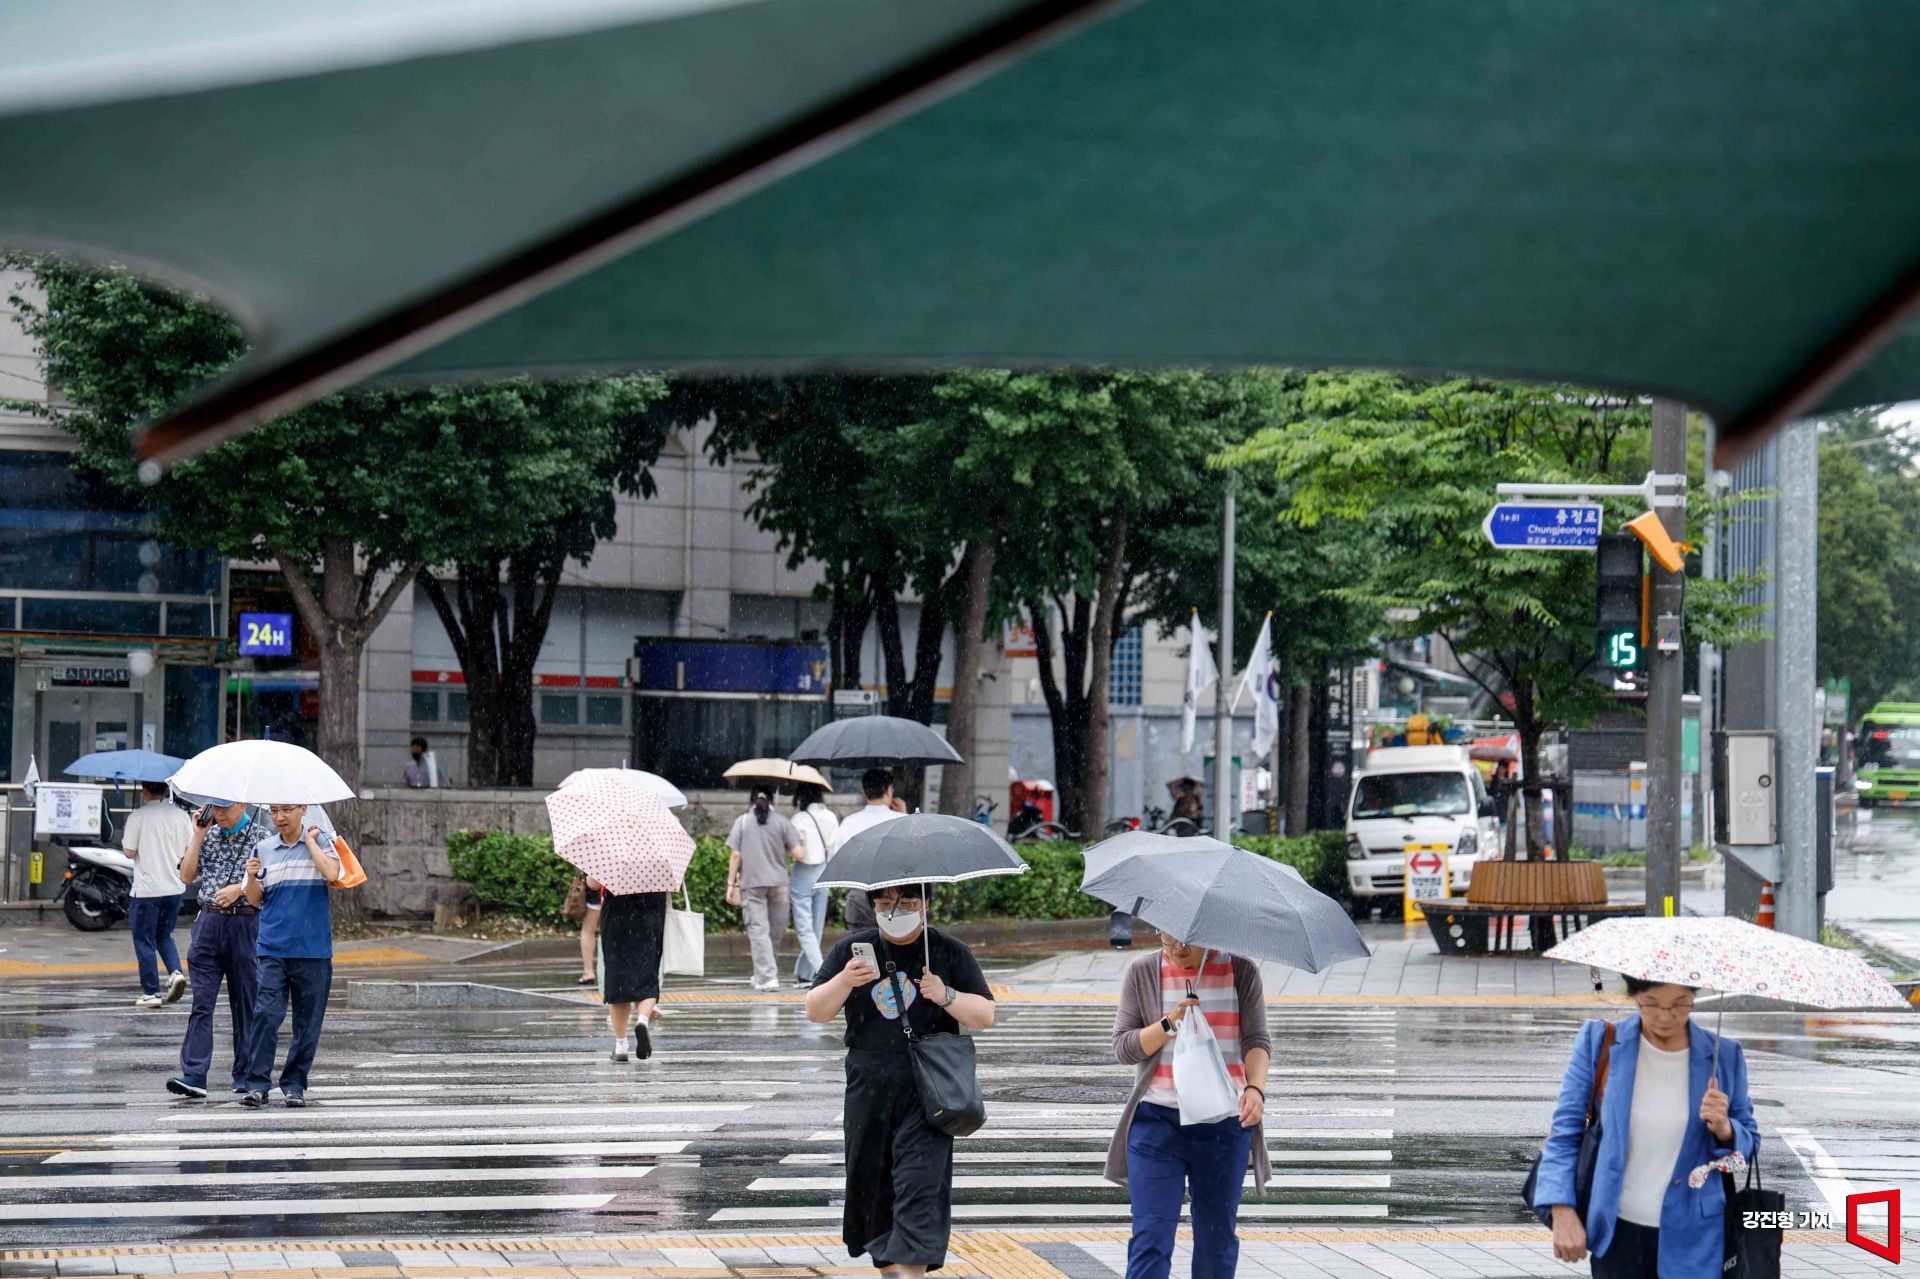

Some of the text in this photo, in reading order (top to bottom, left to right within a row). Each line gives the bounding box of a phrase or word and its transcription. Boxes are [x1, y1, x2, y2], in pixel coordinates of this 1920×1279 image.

[1556, 509, 1598, 525] 충정로
[1528, 524, 1597, 537] Chungjeong-ro
[247, 622, 284, 646] 24H
[1611, 632, 1636, 665] 15
